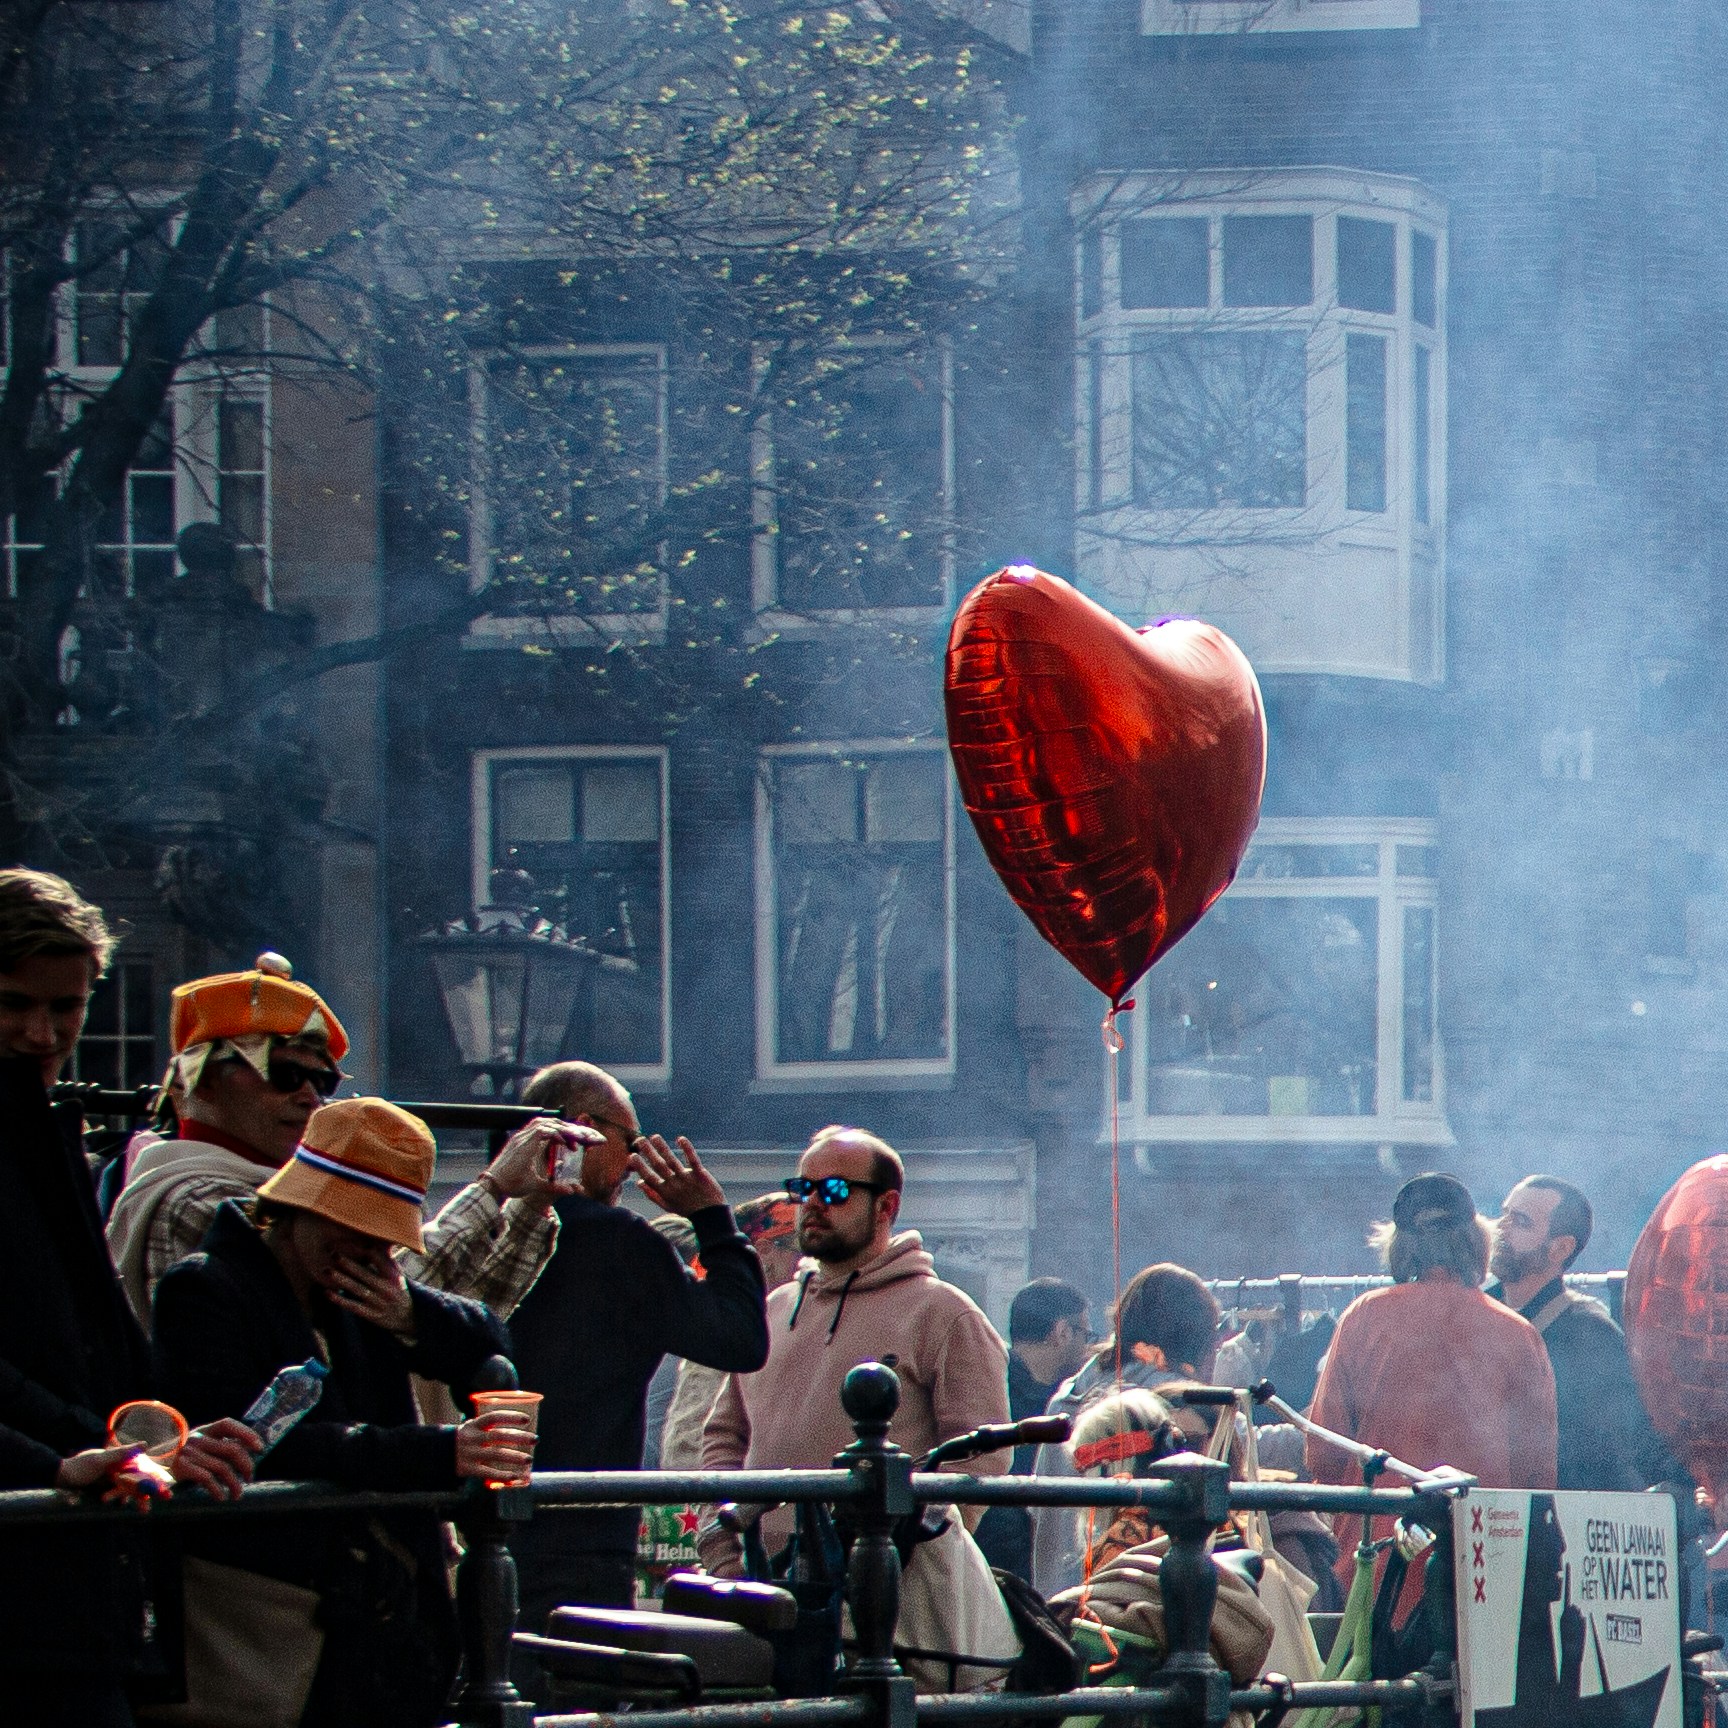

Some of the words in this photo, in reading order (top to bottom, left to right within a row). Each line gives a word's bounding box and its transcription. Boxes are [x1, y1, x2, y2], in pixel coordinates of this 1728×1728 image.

[1586, 1517, 1620, 1554] GEEN
[1621, 1522, 1667, 1557] LAWAAI
[1581, 1579, 1599, 1601] HET
[1599, 1556, 1669, 1600] WATER
[1583, 1554, 1598, 1577] OP
